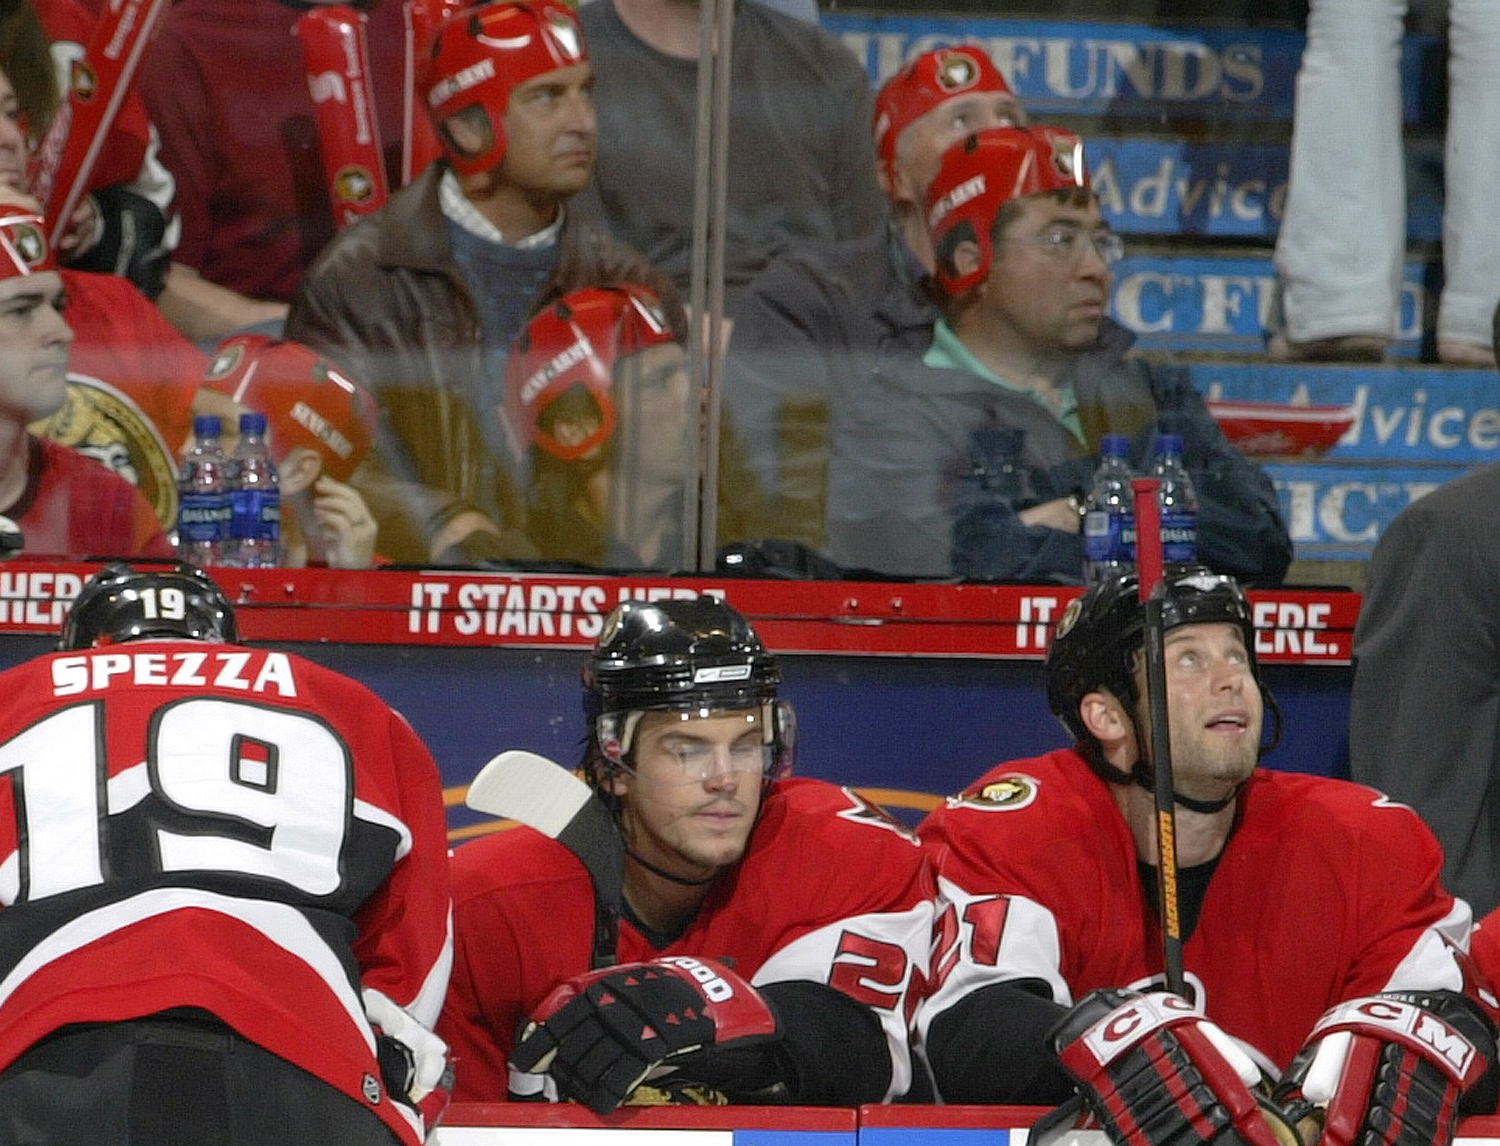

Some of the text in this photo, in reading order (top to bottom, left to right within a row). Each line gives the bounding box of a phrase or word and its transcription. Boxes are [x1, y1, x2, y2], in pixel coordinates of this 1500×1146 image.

[139, 588, 186, 621] 19
[408, 583, 607, 638] IT STARTS
[1015, 597, 1340, 656] IT ERE.
[51, 651, 298, 698] SPEZZA
